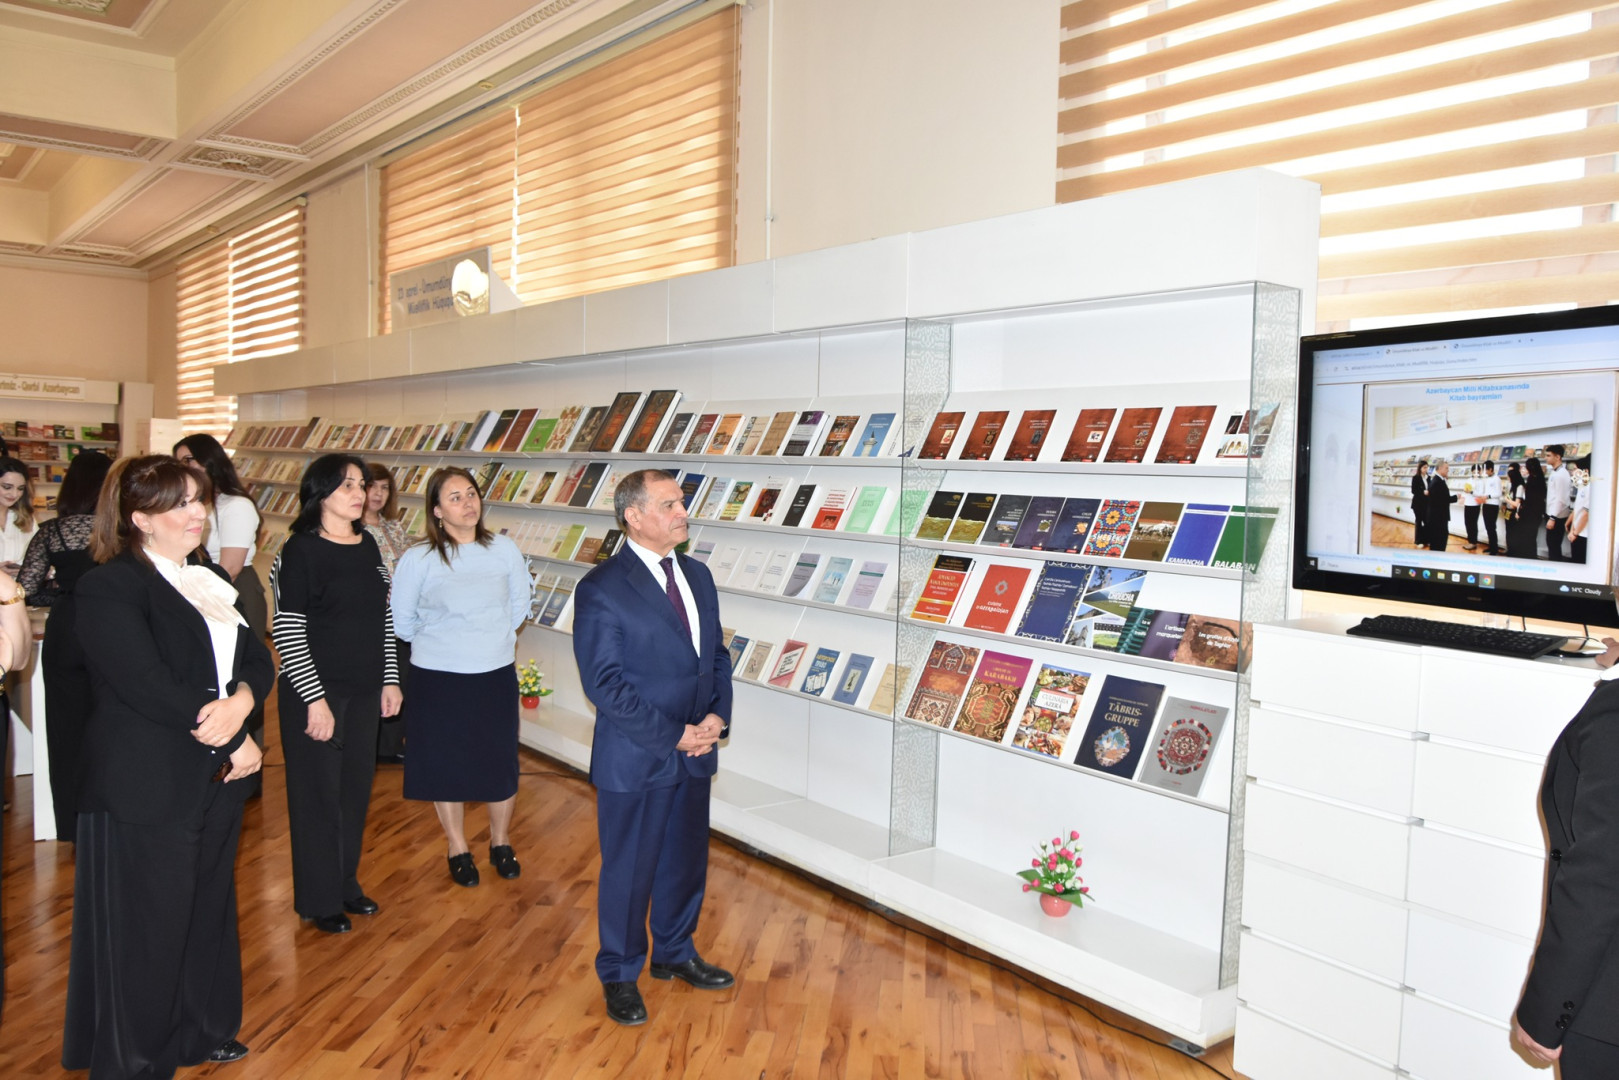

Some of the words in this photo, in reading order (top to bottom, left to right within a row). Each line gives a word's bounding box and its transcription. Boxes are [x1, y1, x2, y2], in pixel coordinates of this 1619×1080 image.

[1463, 385, 1477, 394] Milli
[1167, 557, 1205, 567] KAMANCHA
[1214, 560, 1257, 571] BALABAN
[1107, 592, 1135, 602] CHOUCHA
[1584, 588, 1602, 596] Cloudy
[1108, 701, 1143, 716] TÄBRIS-
[1104, 712, 1140, 727] GRUPPE
